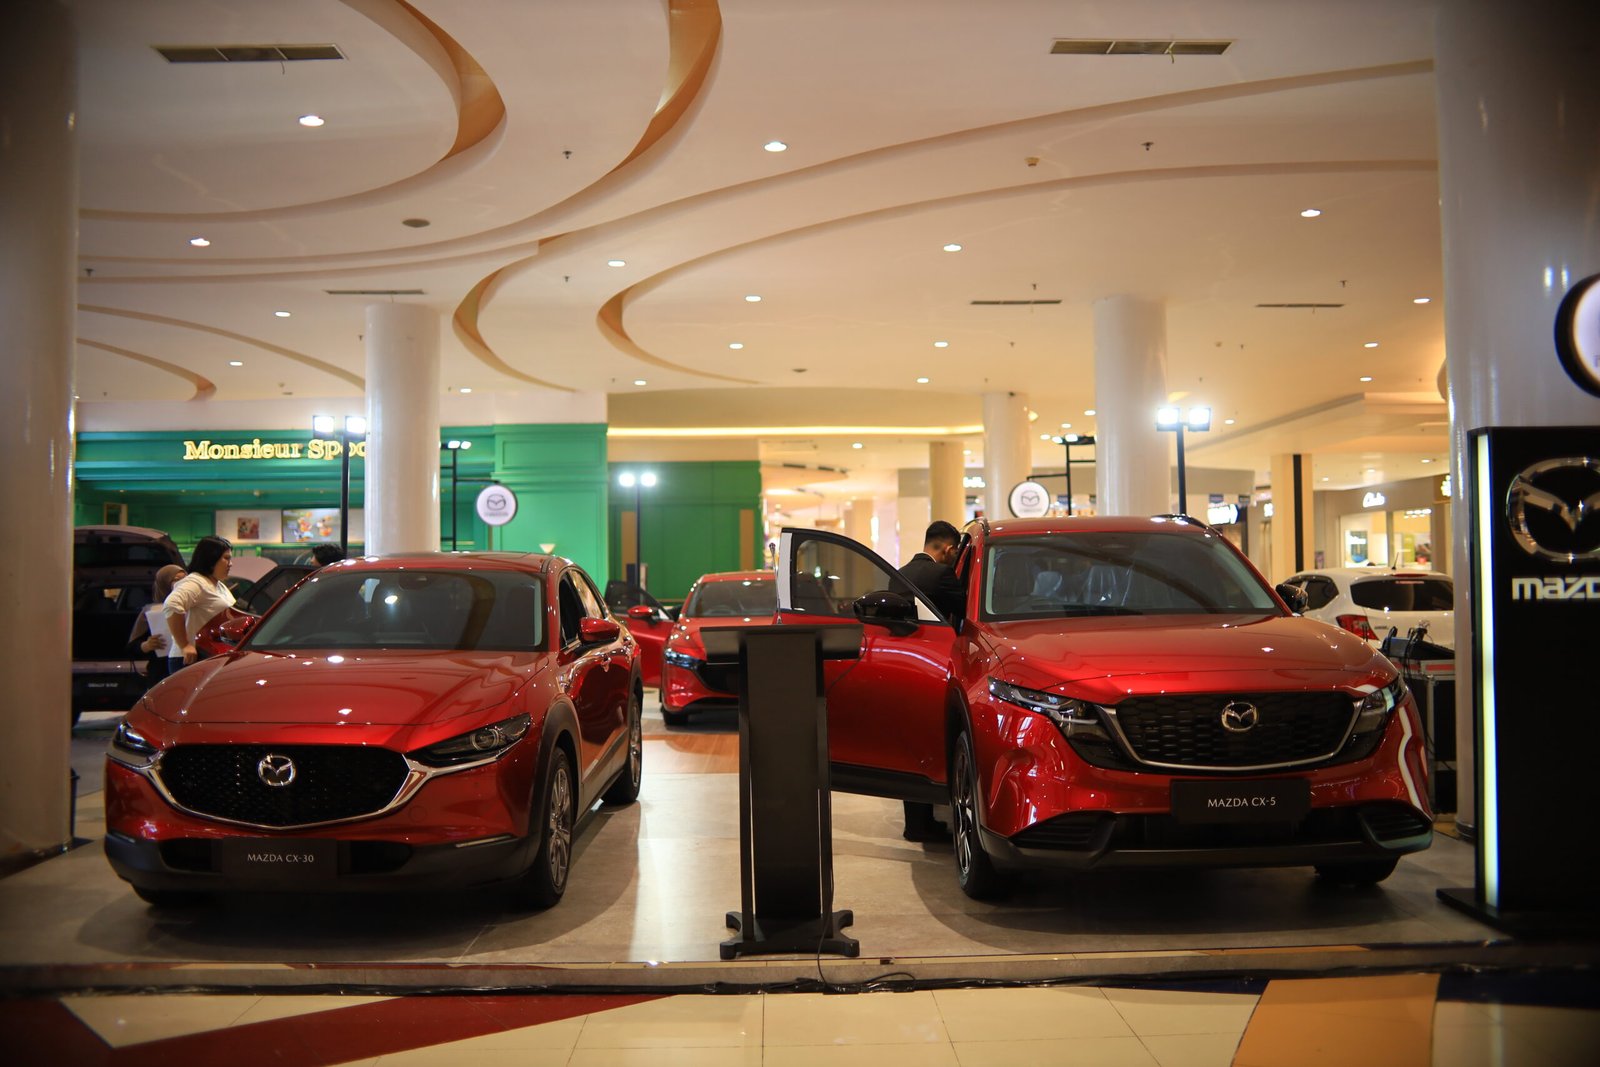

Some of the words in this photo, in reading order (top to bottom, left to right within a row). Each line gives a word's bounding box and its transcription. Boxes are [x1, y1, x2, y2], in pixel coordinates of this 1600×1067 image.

[183, 438, 303, 460] Monsieur
[1207, 797, 1249, 808] MAZDA
[1251, 796, 1276, 807] CX-5
[247, 853, 283, 862] MAZDA
[285, 854, 314, 863] CX-30
